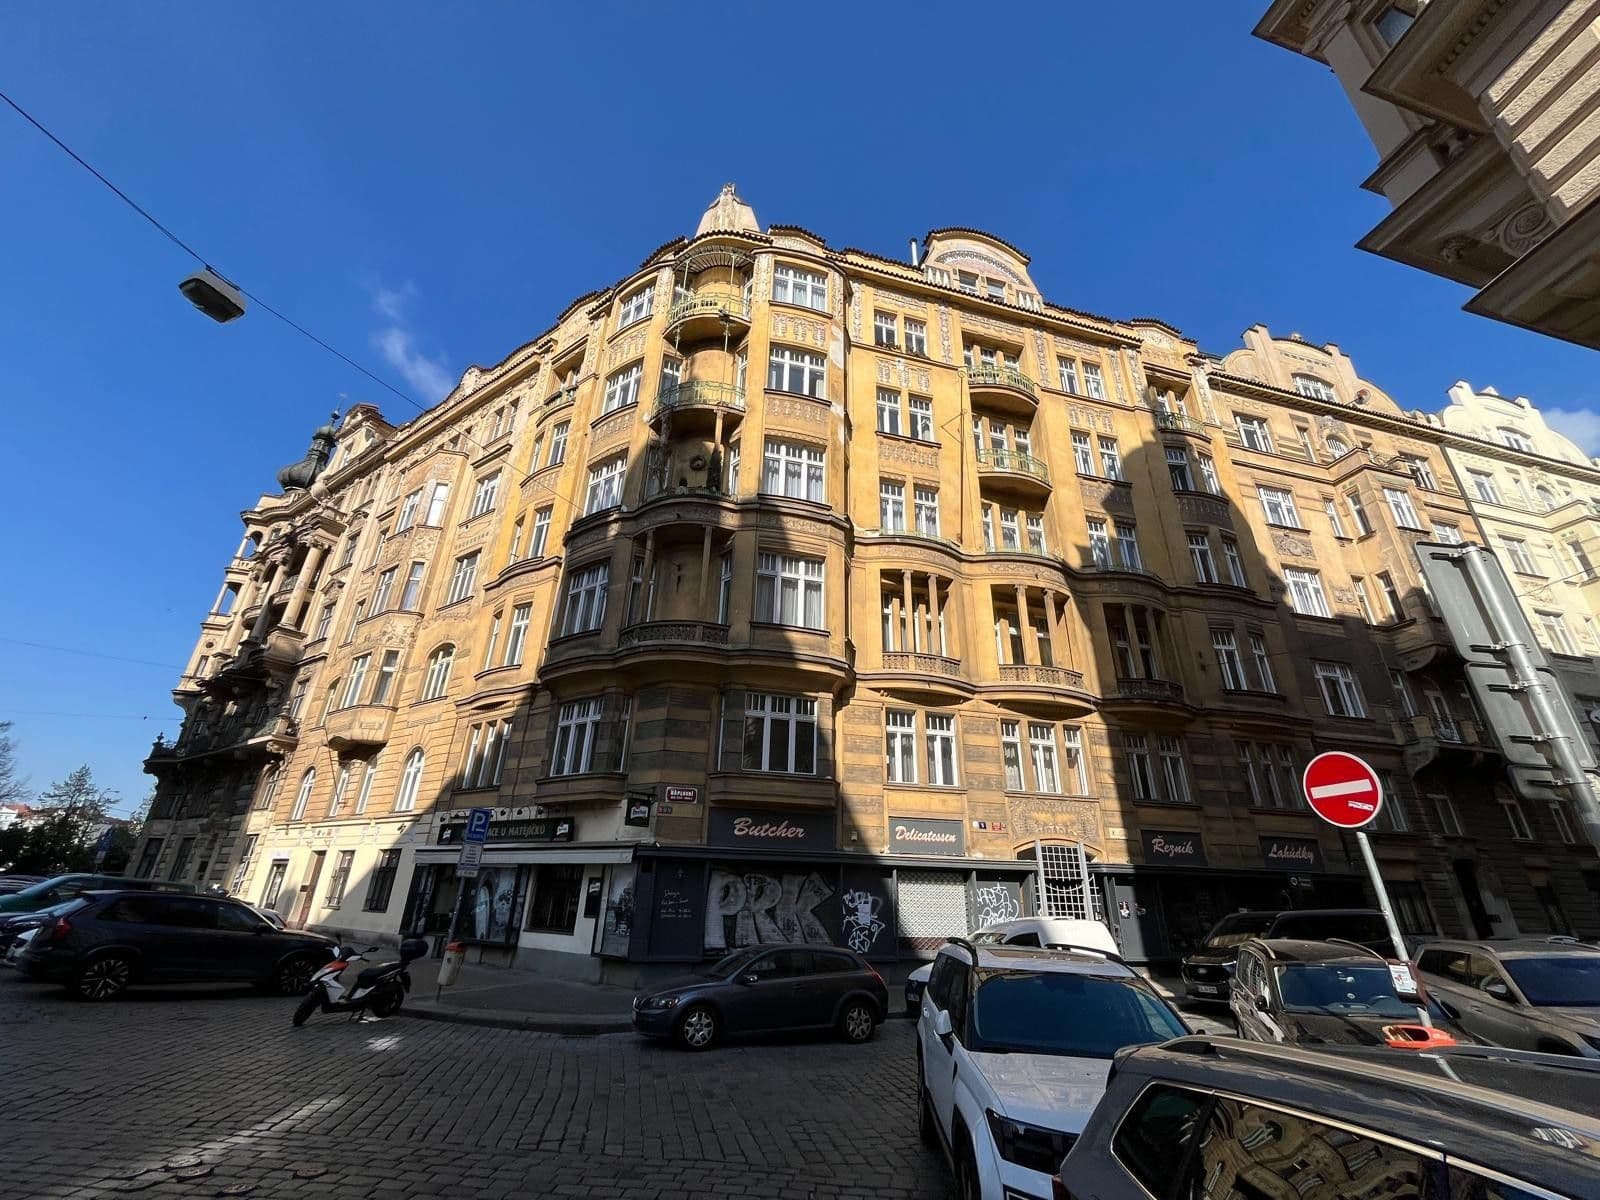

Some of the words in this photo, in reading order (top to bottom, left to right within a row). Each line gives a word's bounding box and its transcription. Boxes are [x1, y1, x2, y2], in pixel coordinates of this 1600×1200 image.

[472, 813, 486, 832] P
[733, 817, 806, 838] Butcher
[895, 825, 957, 843] Delicatessen
[1152, 834, 1194, 857] Řezník
